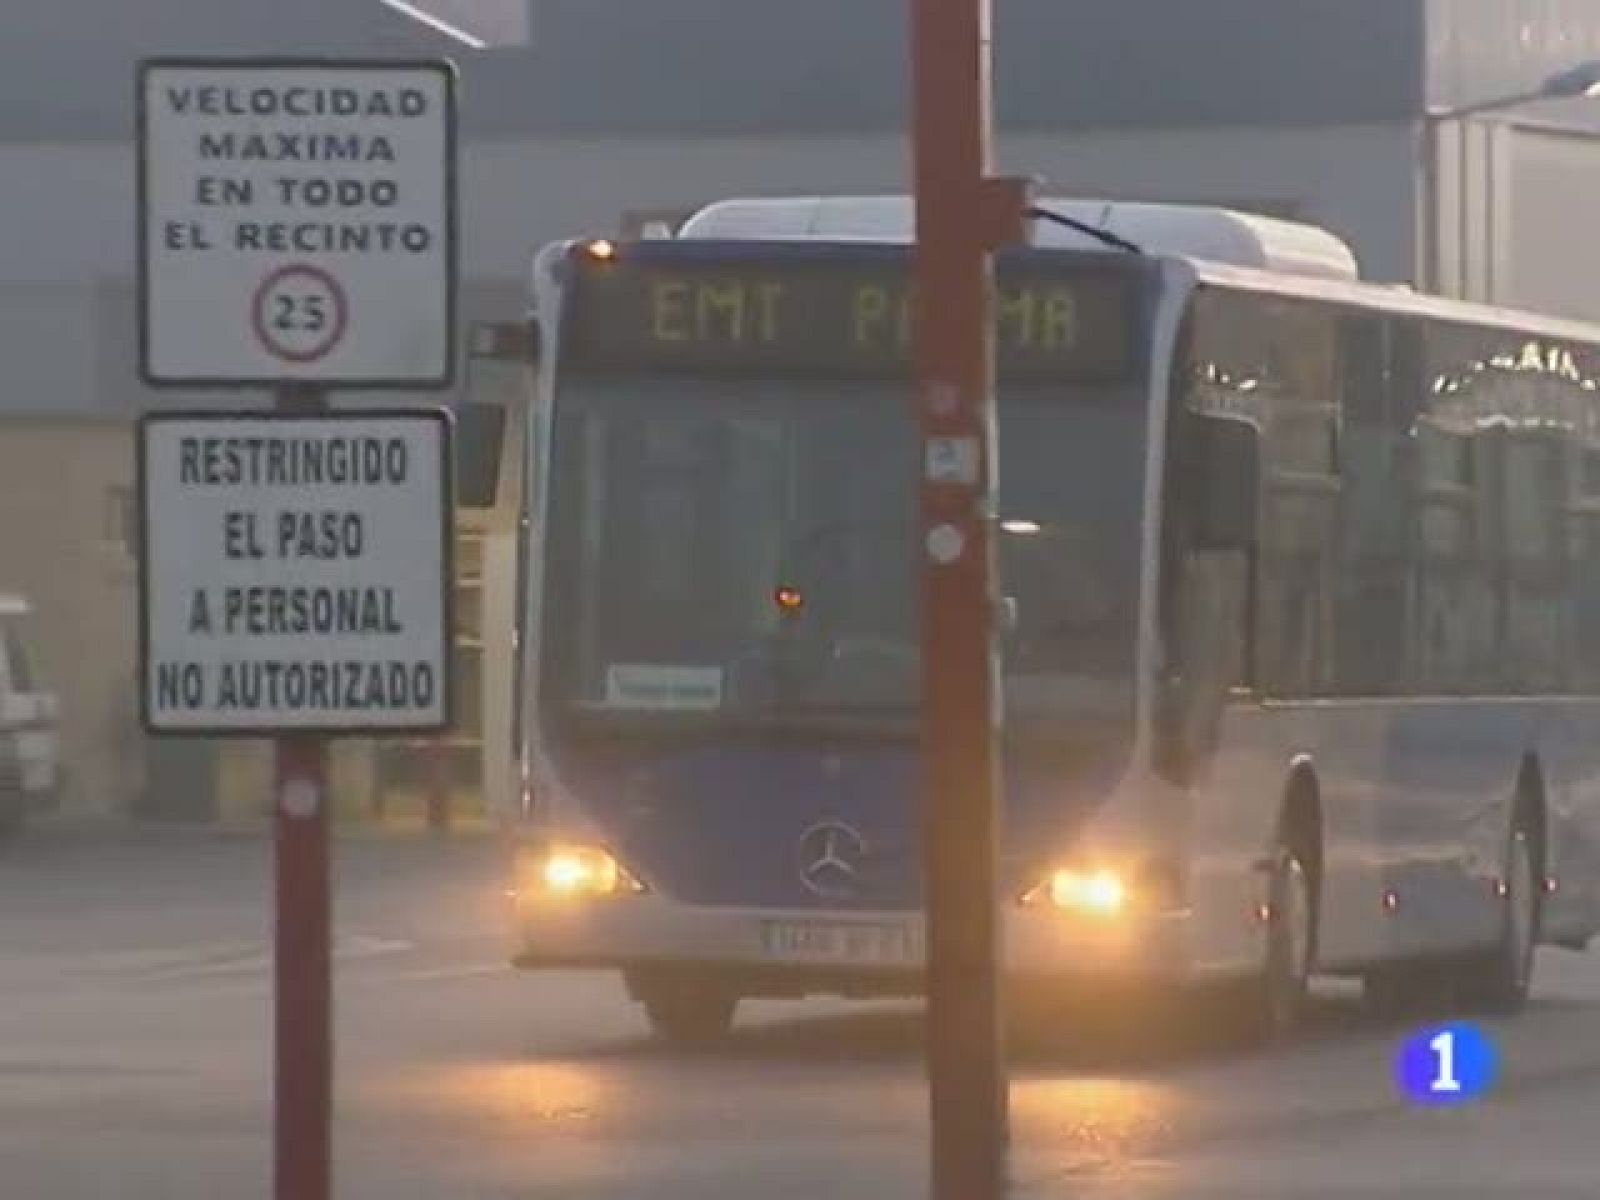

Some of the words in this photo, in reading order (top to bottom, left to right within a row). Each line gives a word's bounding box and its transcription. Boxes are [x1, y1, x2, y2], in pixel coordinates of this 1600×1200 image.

[167, 87, 426, 117] VELOCIDAD
[199, 133, 395, 161] MAXIMA
[197, 178, 251, 205] EN
[277, 178, 399, 206] TODO
[165, 221, 211, 250] EL
[236, 222, 431, 252] RECINTO
[274, 294, 326, 331] 25
[652, 281, 785, 343] EMT
[179, 437, 407, 485] RESTRINGIDO
[224, 511, 265, 560] EL
[278, 511, 363, 559] PASO
[189, 586, 212, 635] A
[223, 586, 403, 634] PERSONAL
[157, 660, 203, 711] NO
[218, 660, 434, 711] AUTORIZADO
